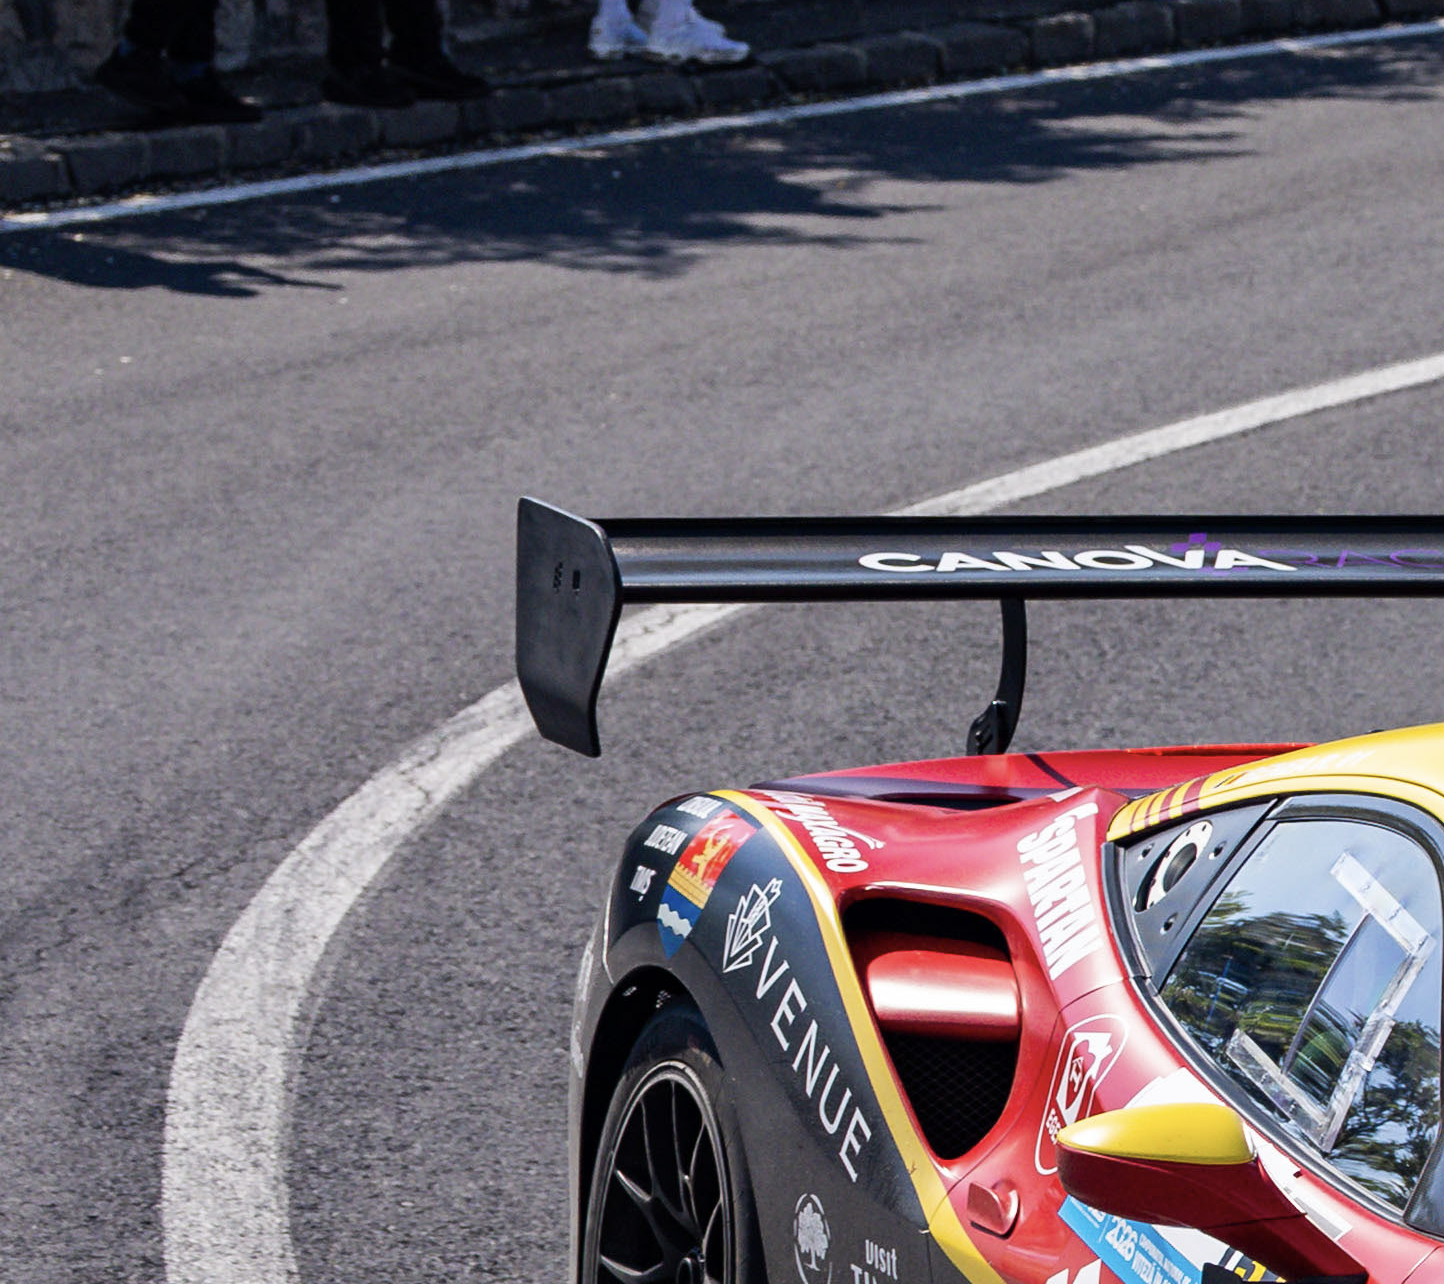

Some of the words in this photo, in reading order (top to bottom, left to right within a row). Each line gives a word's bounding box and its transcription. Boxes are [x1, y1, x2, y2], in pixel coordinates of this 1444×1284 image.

[857, 544, 1298, 573] CANOVA
[1016, 806, 1105, 982] SPARTAN
[755, 936, 873, 1183] VENUE
[865, 1238, 898, 1275] visit
[1104, 1216, 1138, 1262] 2026
